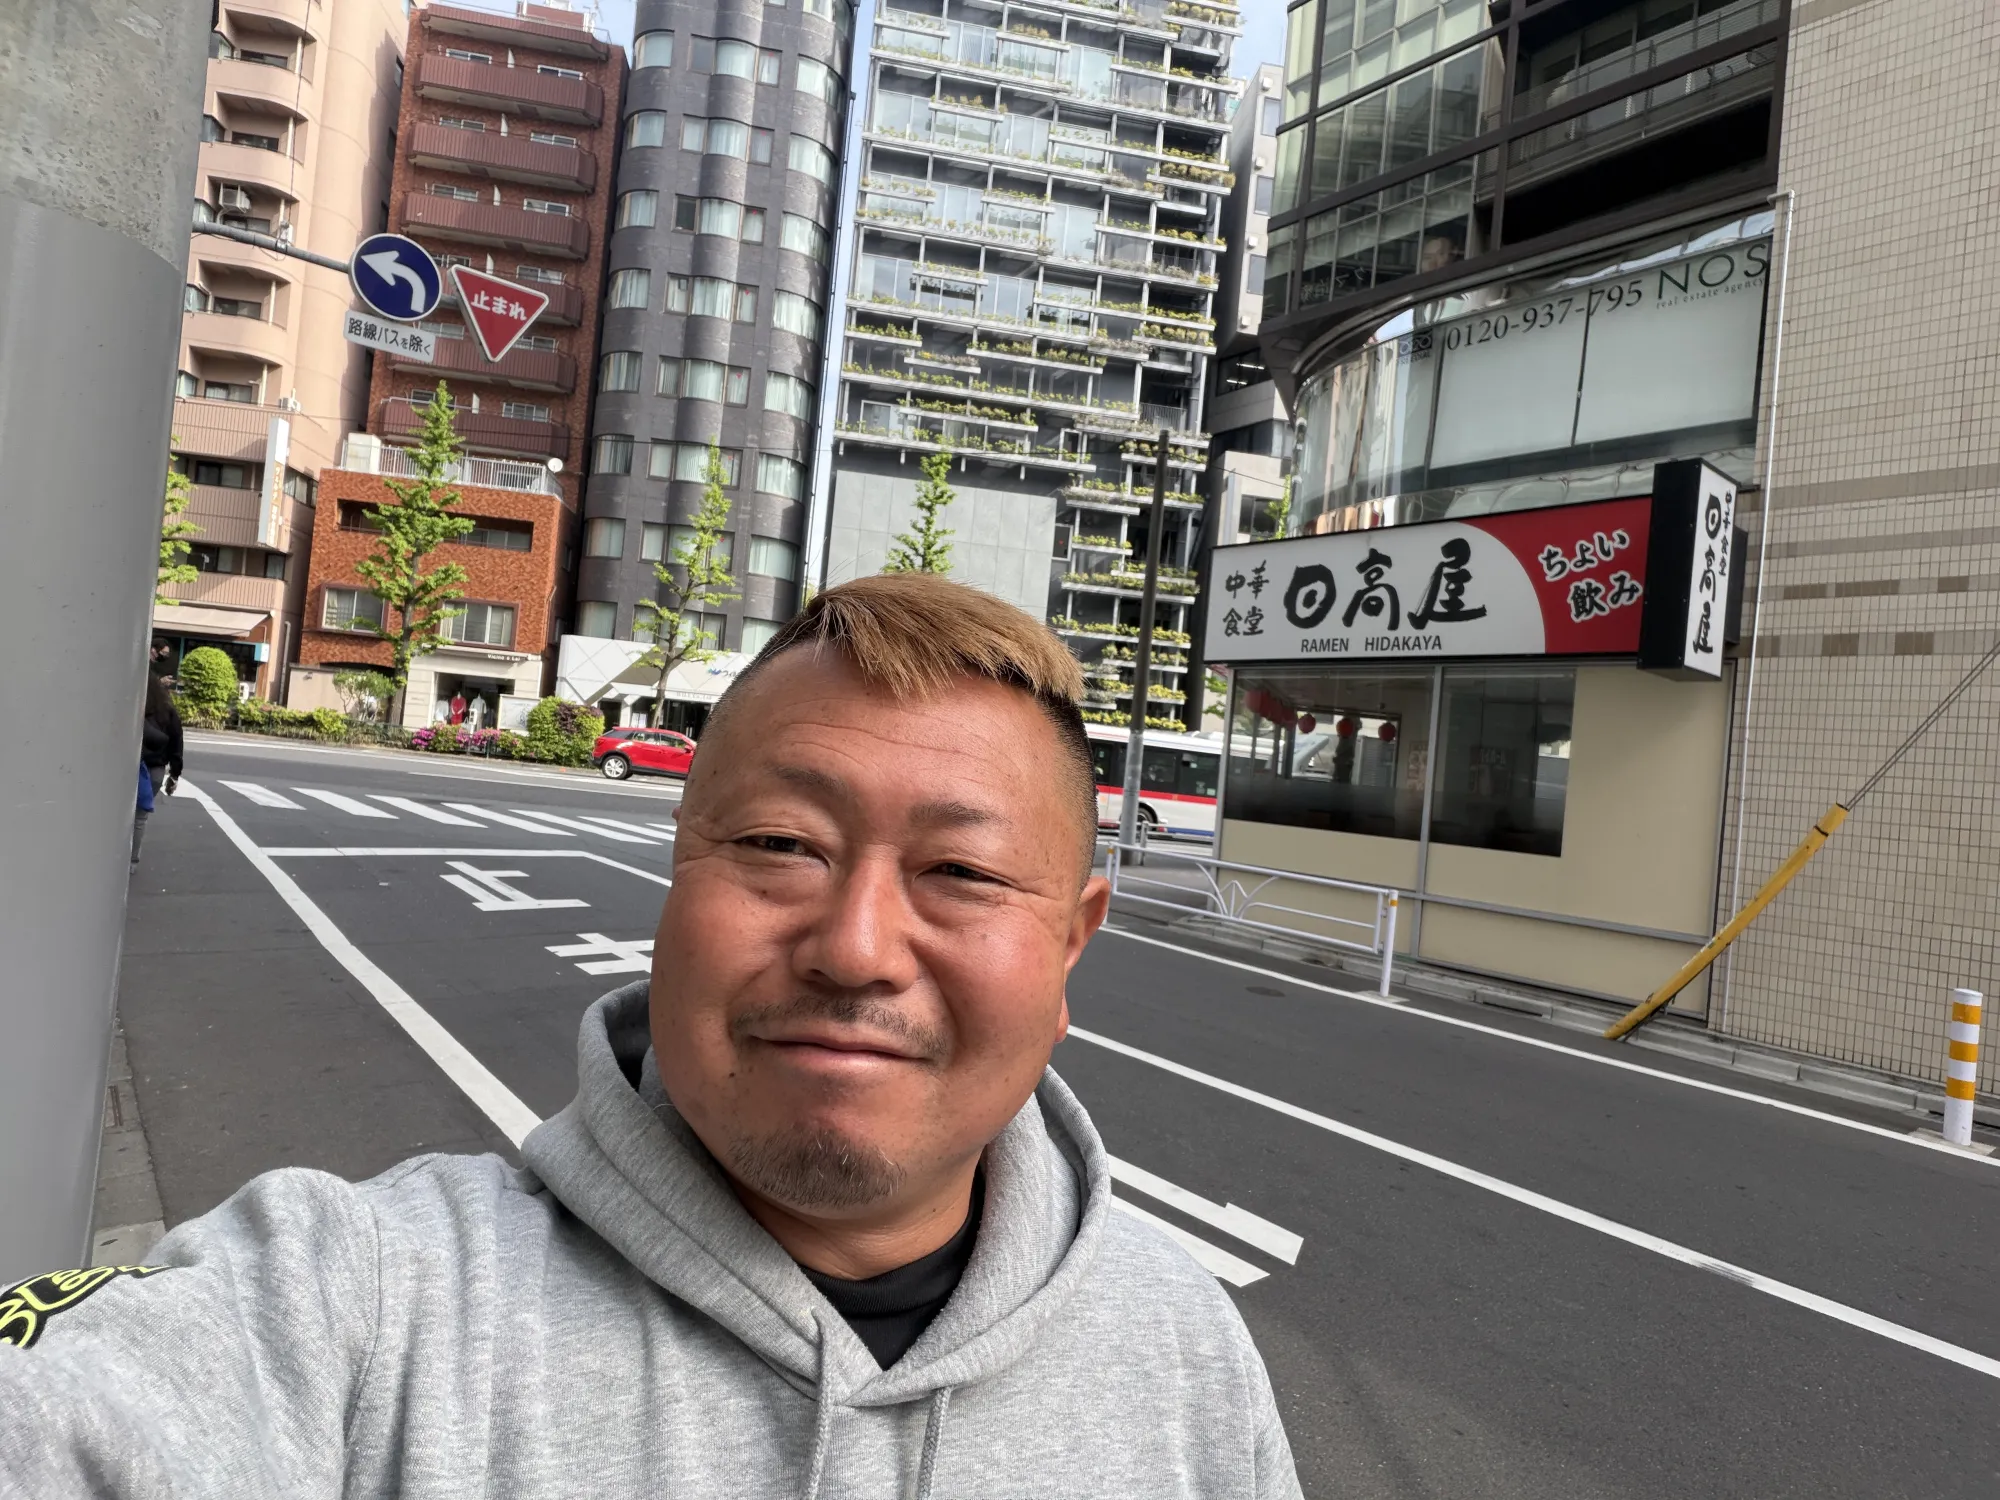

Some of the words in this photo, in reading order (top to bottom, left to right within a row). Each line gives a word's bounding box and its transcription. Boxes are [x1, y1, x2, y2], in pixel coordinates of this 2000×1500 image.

[1656, 296, 1679, 310] real
[1683, 289, 1720, 303] estate
[1724, 278, 1764, 295] agency
[1657, 243, 1767, 300] NOS
[470, 289, 527, 321] 止まれ
[1446, 279, 1643, 350] 0120-937-795
[347, 316, 432, 356] 路線バスを除く
[1539, 530, 1629, 581] ちょい
[1692, 491, 1722, 655] 日高屋
[1224, 559, 1270, 600] 中華
[1283, 537, 1488, 630] 日高屋
[1567, 571, 1642, 623] 飲み
[1222, 605, 1264, 637] 食堂
[1300, 638, 1349, 653] RAMEN
[1364, 634, 1443, 652] HIDAKAYA
